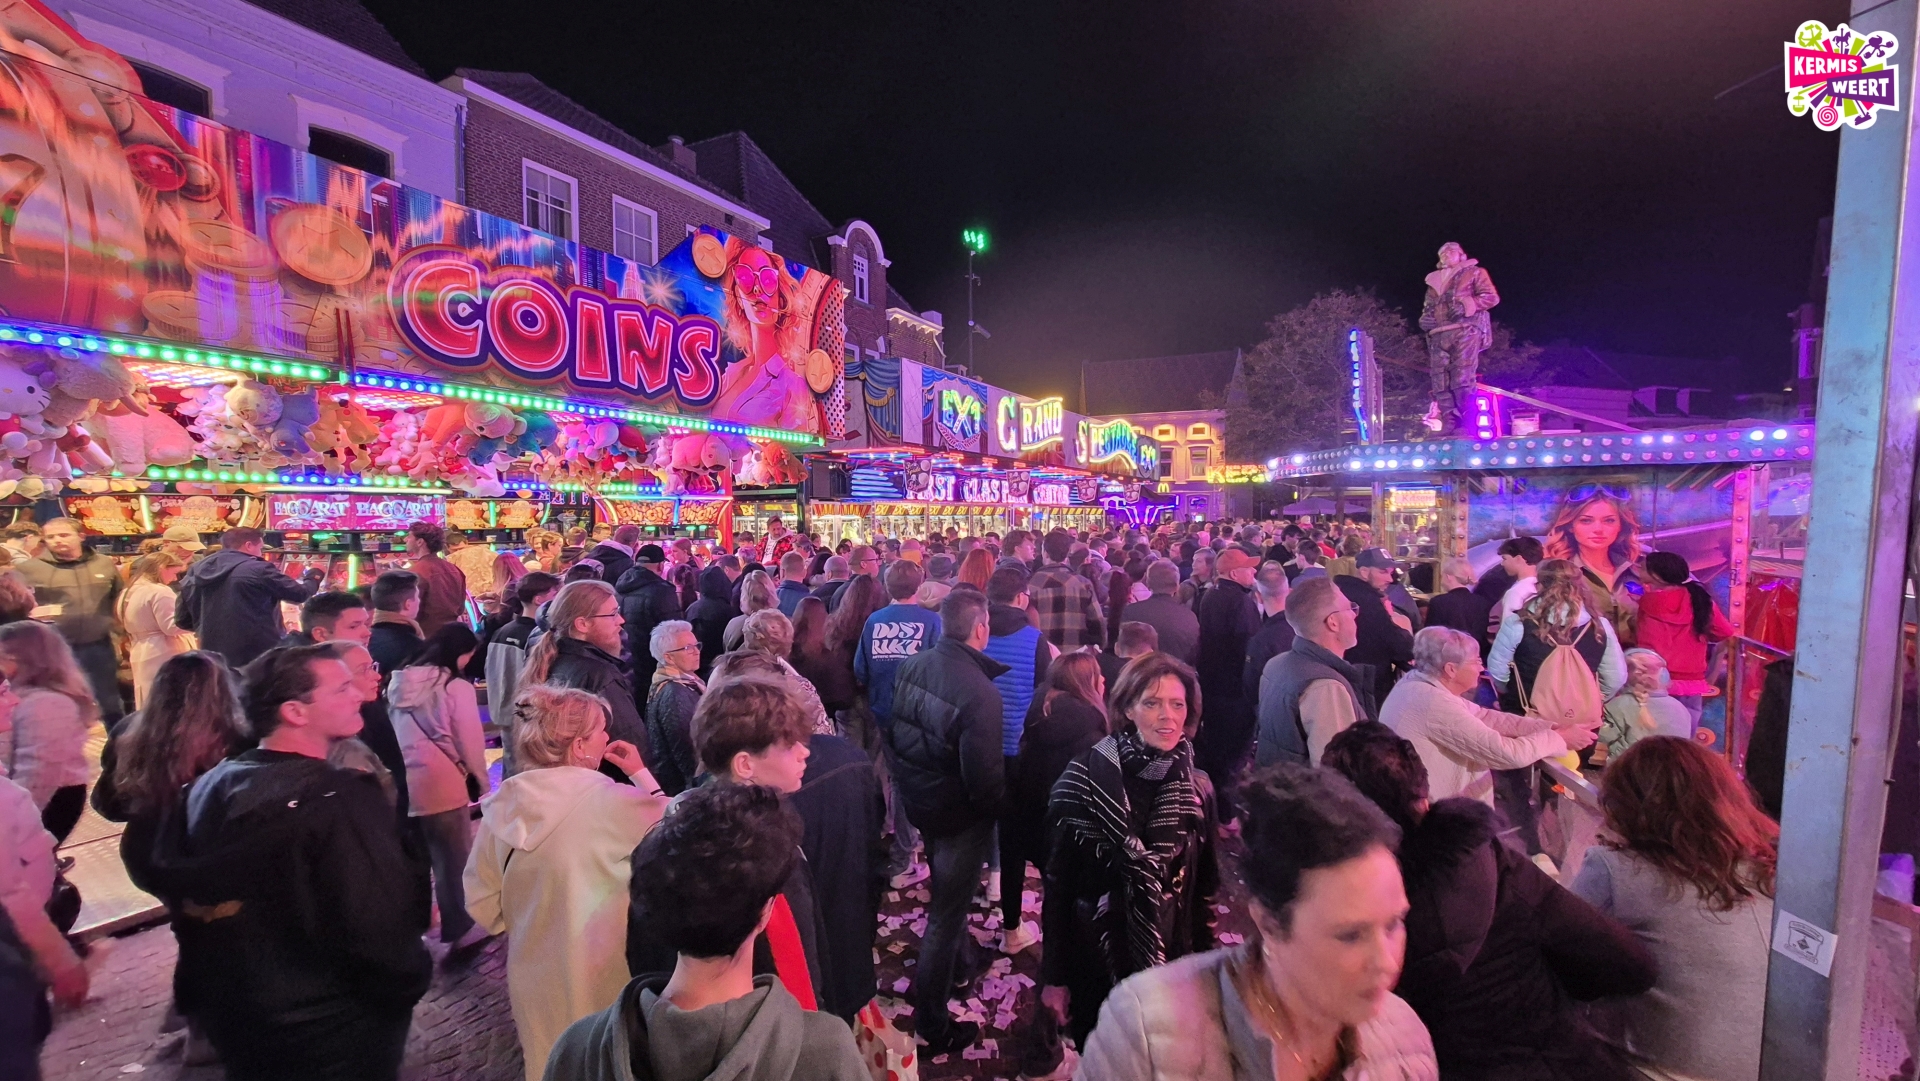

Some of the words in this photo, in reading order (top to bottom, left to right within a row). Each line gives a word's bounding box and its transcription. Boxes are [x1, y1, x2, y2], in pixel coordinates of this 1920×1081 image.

[403, 257, 719, 402] COINS
[997, 396, 1063, 452] GRAND
[275, 499, 350, 519] BACCARAT
[356, 499, 434, 519] BACCARAT
